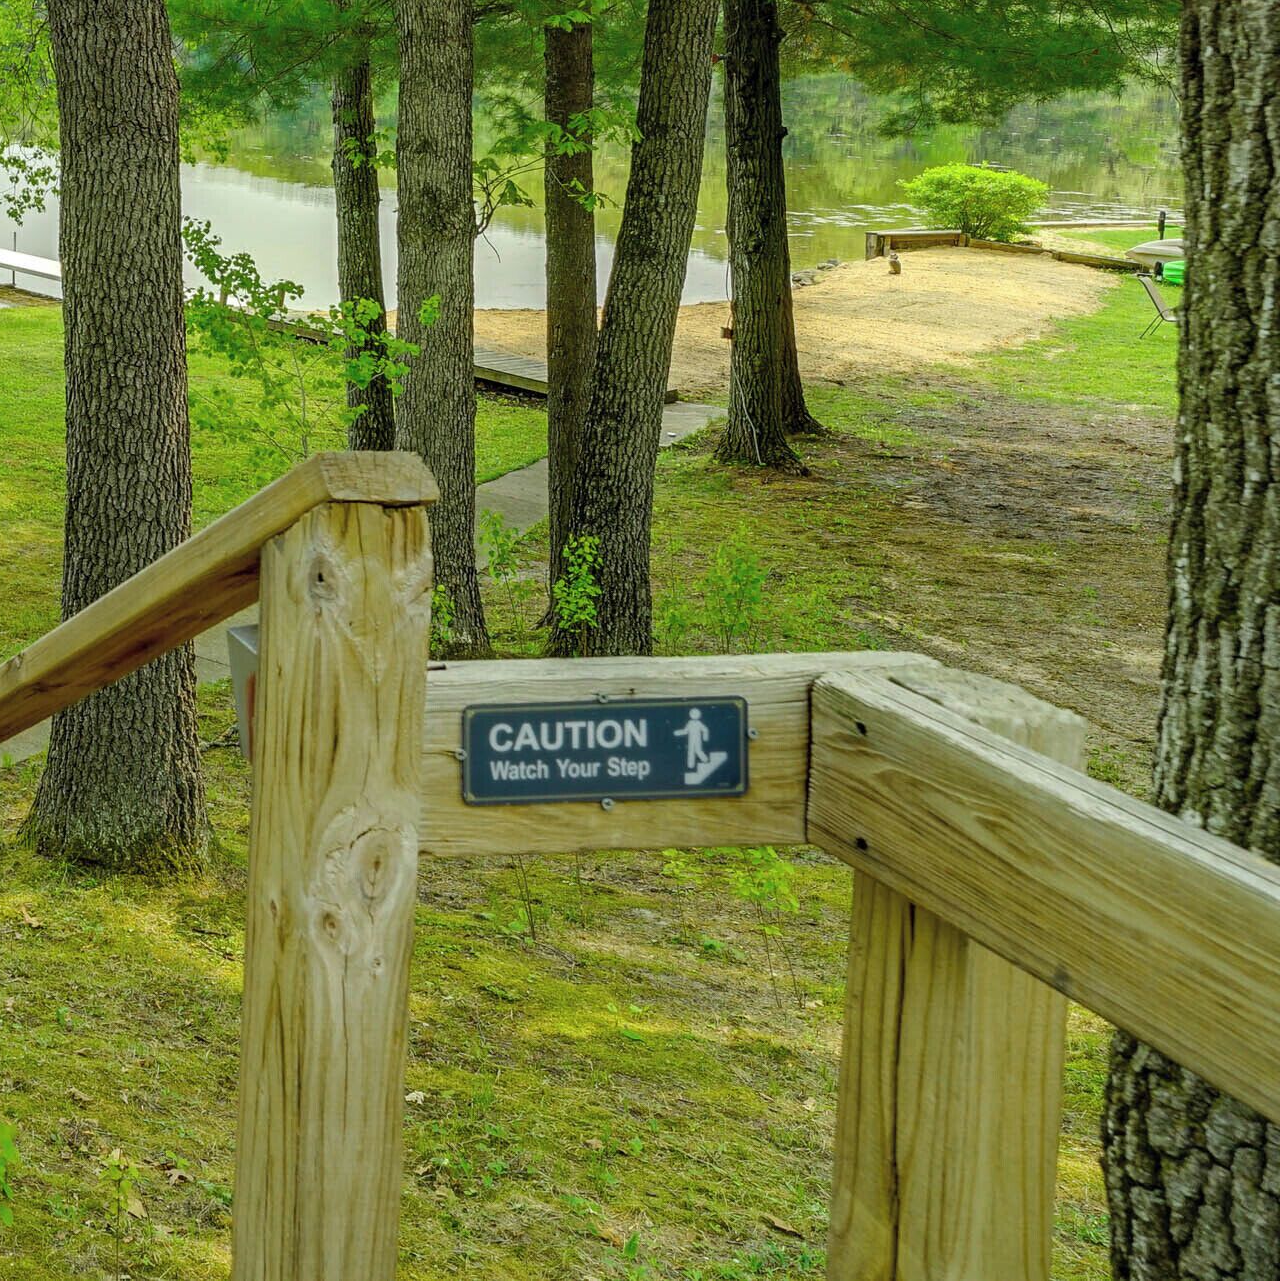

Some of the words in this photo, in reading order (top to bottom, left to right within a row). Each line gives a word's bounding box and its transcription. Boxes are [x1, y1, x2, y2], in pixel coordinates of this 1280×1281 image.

[489, 719, 648, 752] CAUTION
[490, 759, 549, 781] Watch
[556, 758, 600, 778] Your
[608, 756, 651, 780] Step
